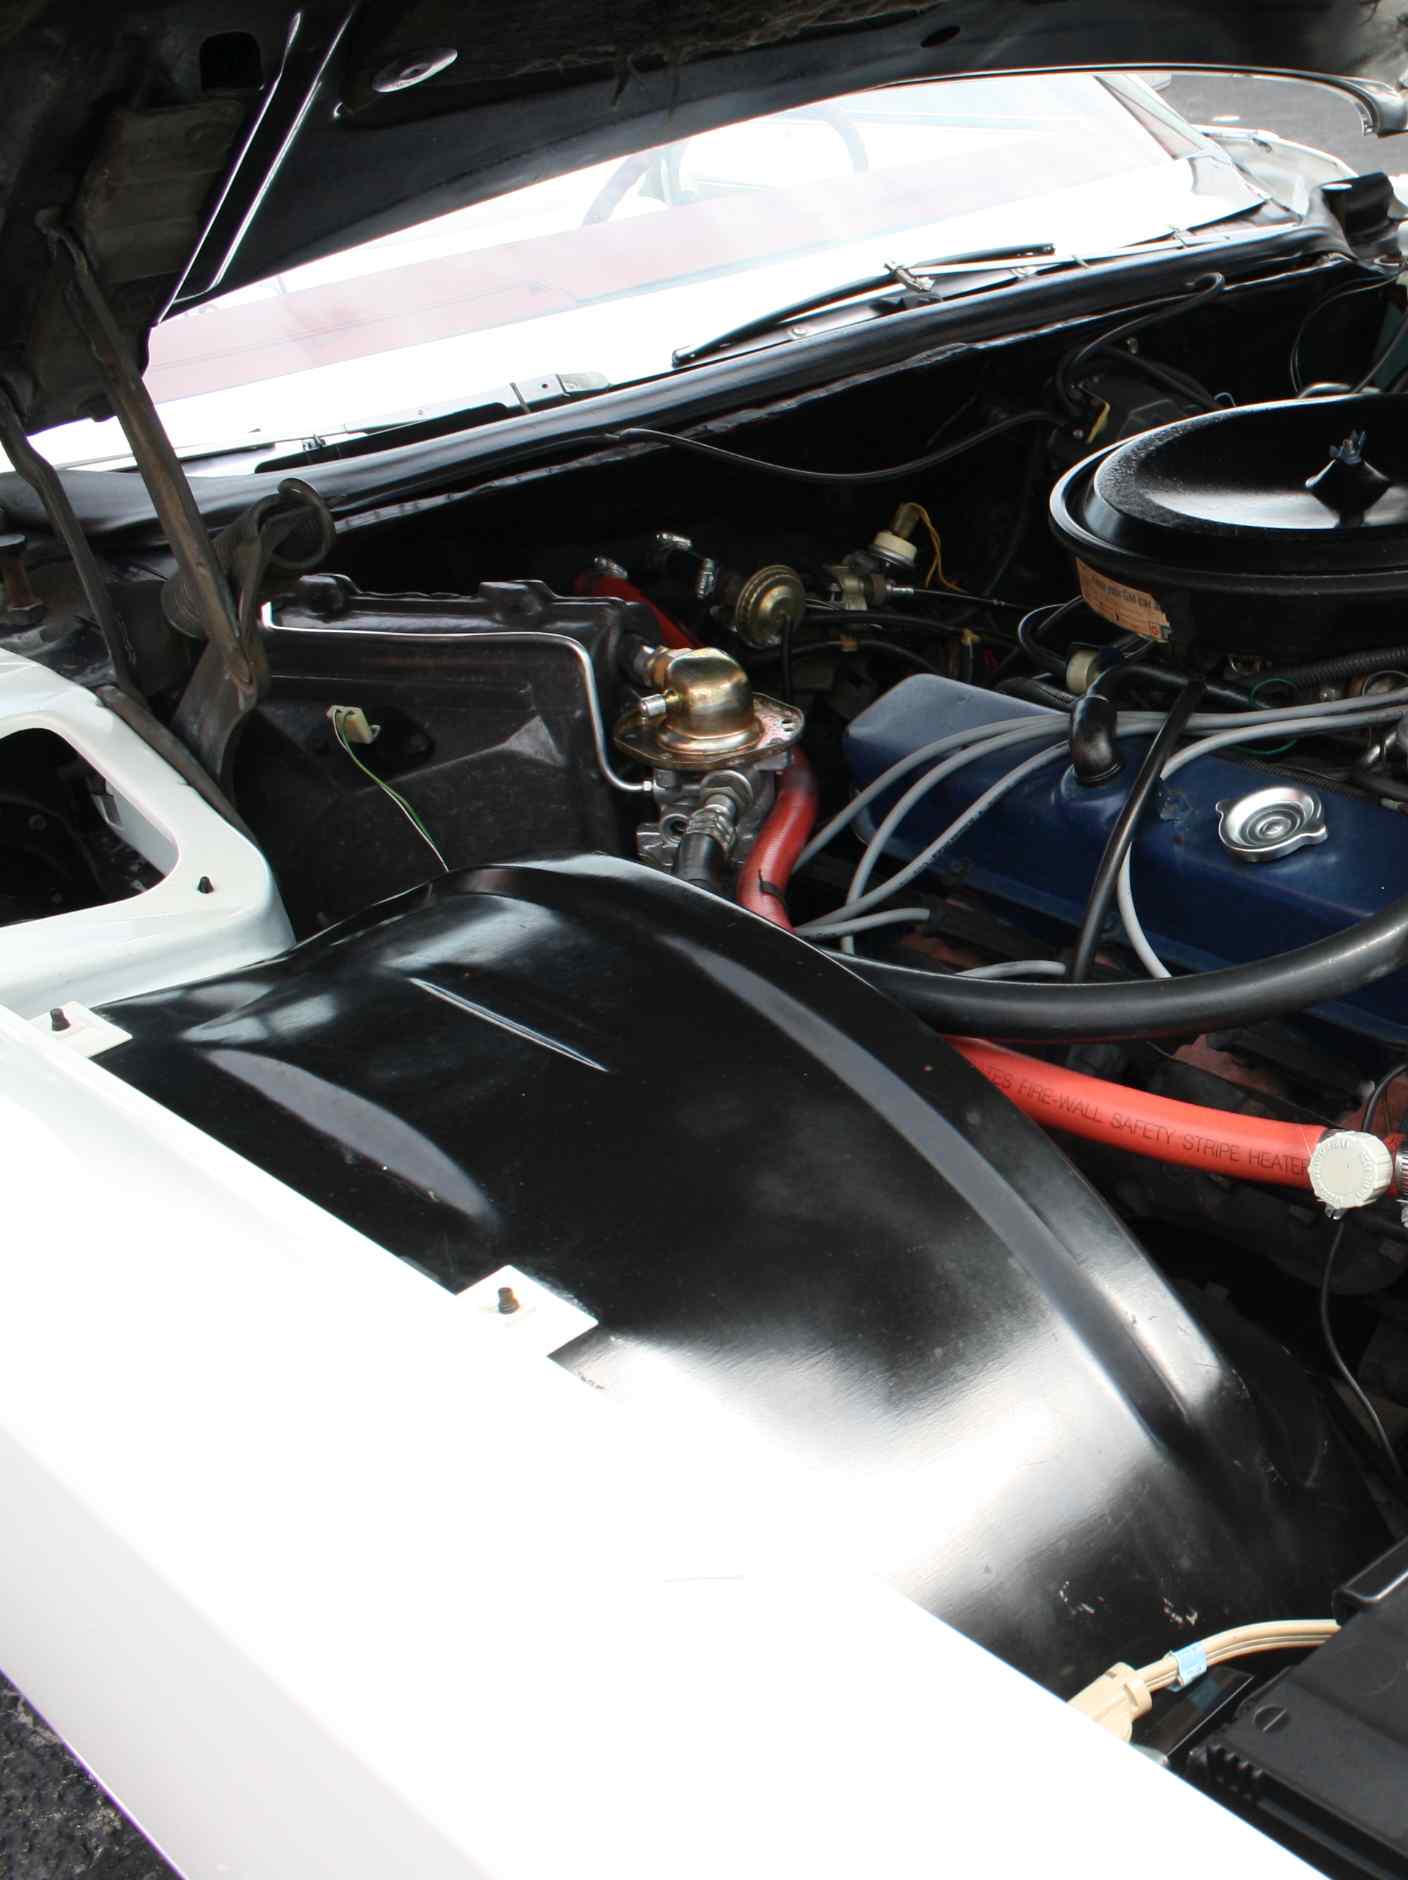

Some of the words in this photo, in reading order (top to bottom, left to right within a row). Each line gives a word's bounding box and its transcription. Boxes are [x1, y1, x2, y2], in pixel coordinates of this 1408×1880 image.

[1017, 1080, 1104, 1124] FIRE-WALL
[1111, 1112, 1176, 1145] SAFETY
[1182, 1134, 1240, 1162] STRIPE
[1248, 1151, 1309, 1175] HEATER
